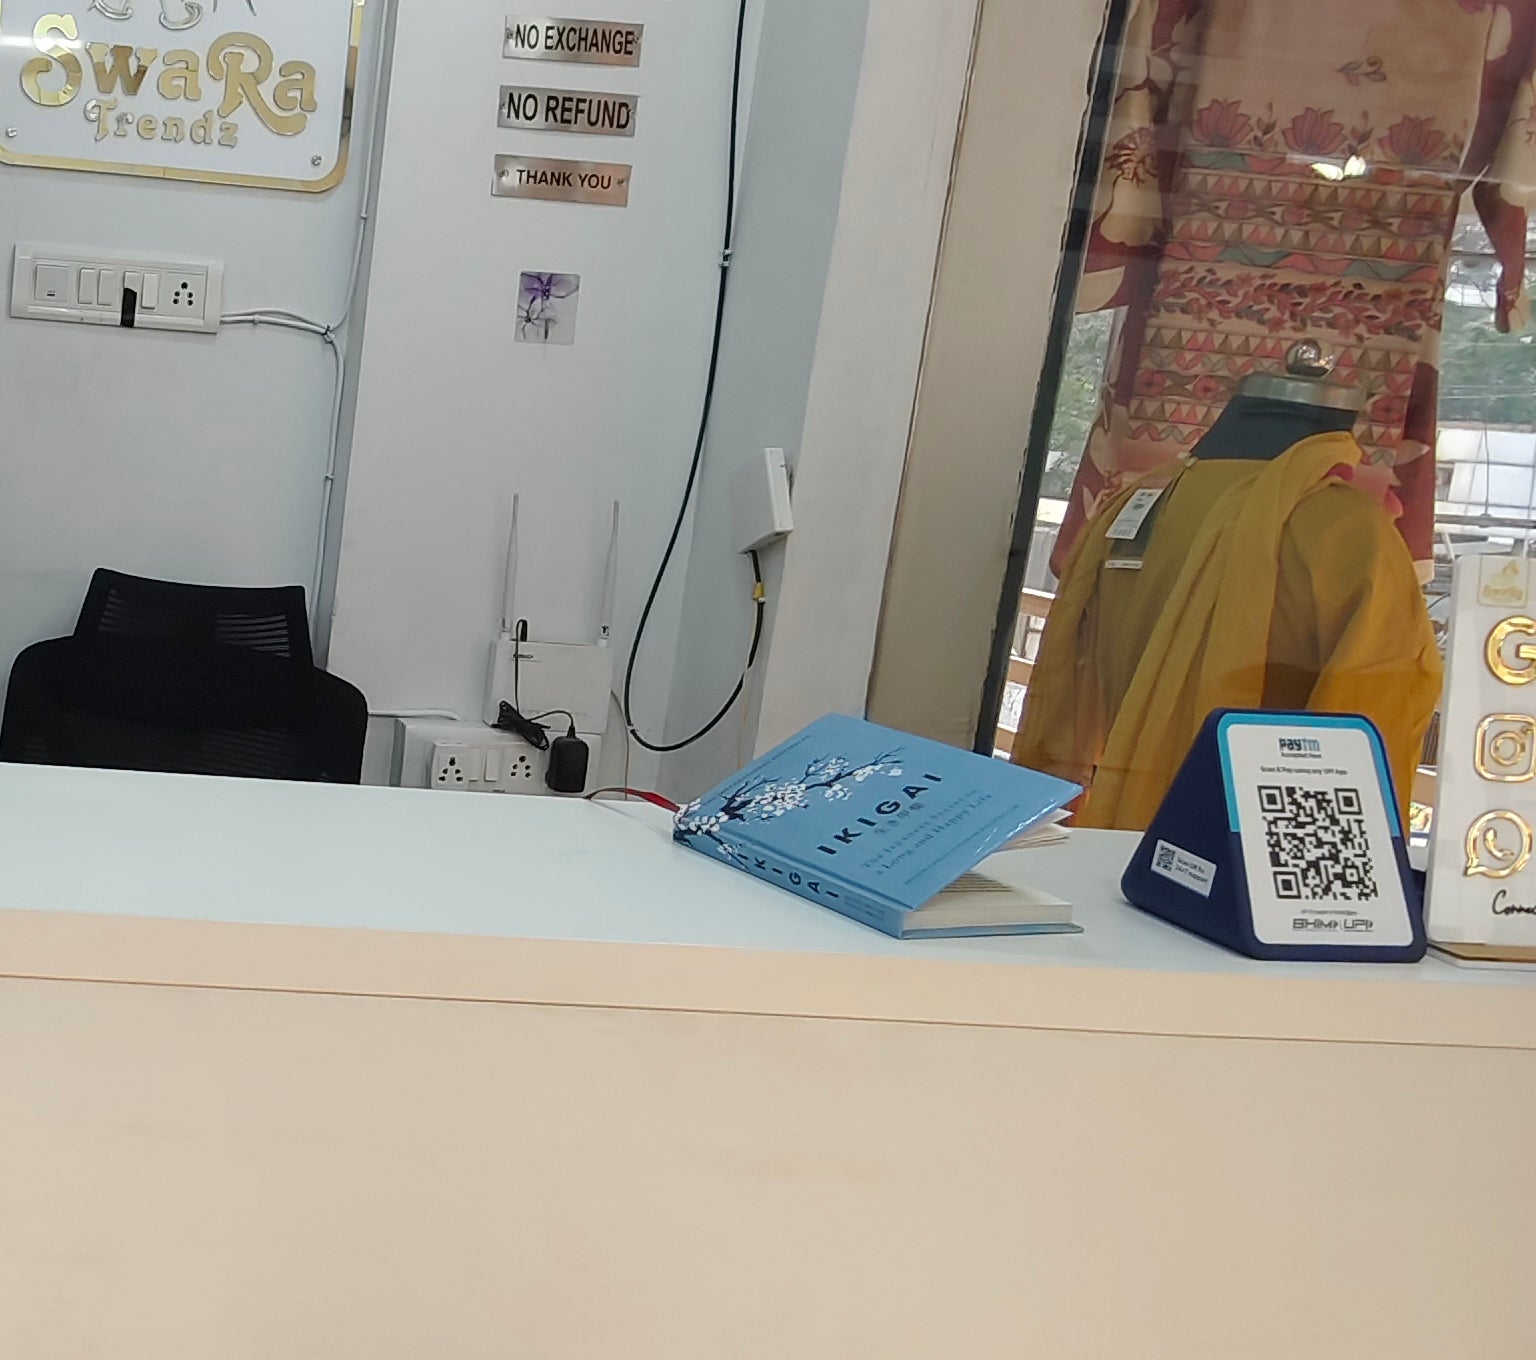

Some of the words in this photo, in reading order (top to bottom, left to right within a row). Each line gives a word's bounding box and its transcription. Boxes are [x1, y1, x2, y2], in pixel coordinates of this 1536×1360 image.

[514, 24, 539, 49] NO
[544, 26, 635, 55] EXCHANGE
[20, 13, 318, 136] SwaRa
[84, 98, 240, 148] Trendz
[506, 92, 538, 121] NO
[544, 95, 630, 129] REFUND
[517, 169, 573, 187] THANK
[578, 173, 612, 190] YOU
[817, 773, 942, 855] IKIGAI
[737, 843, 839, 898] IKIGAI
